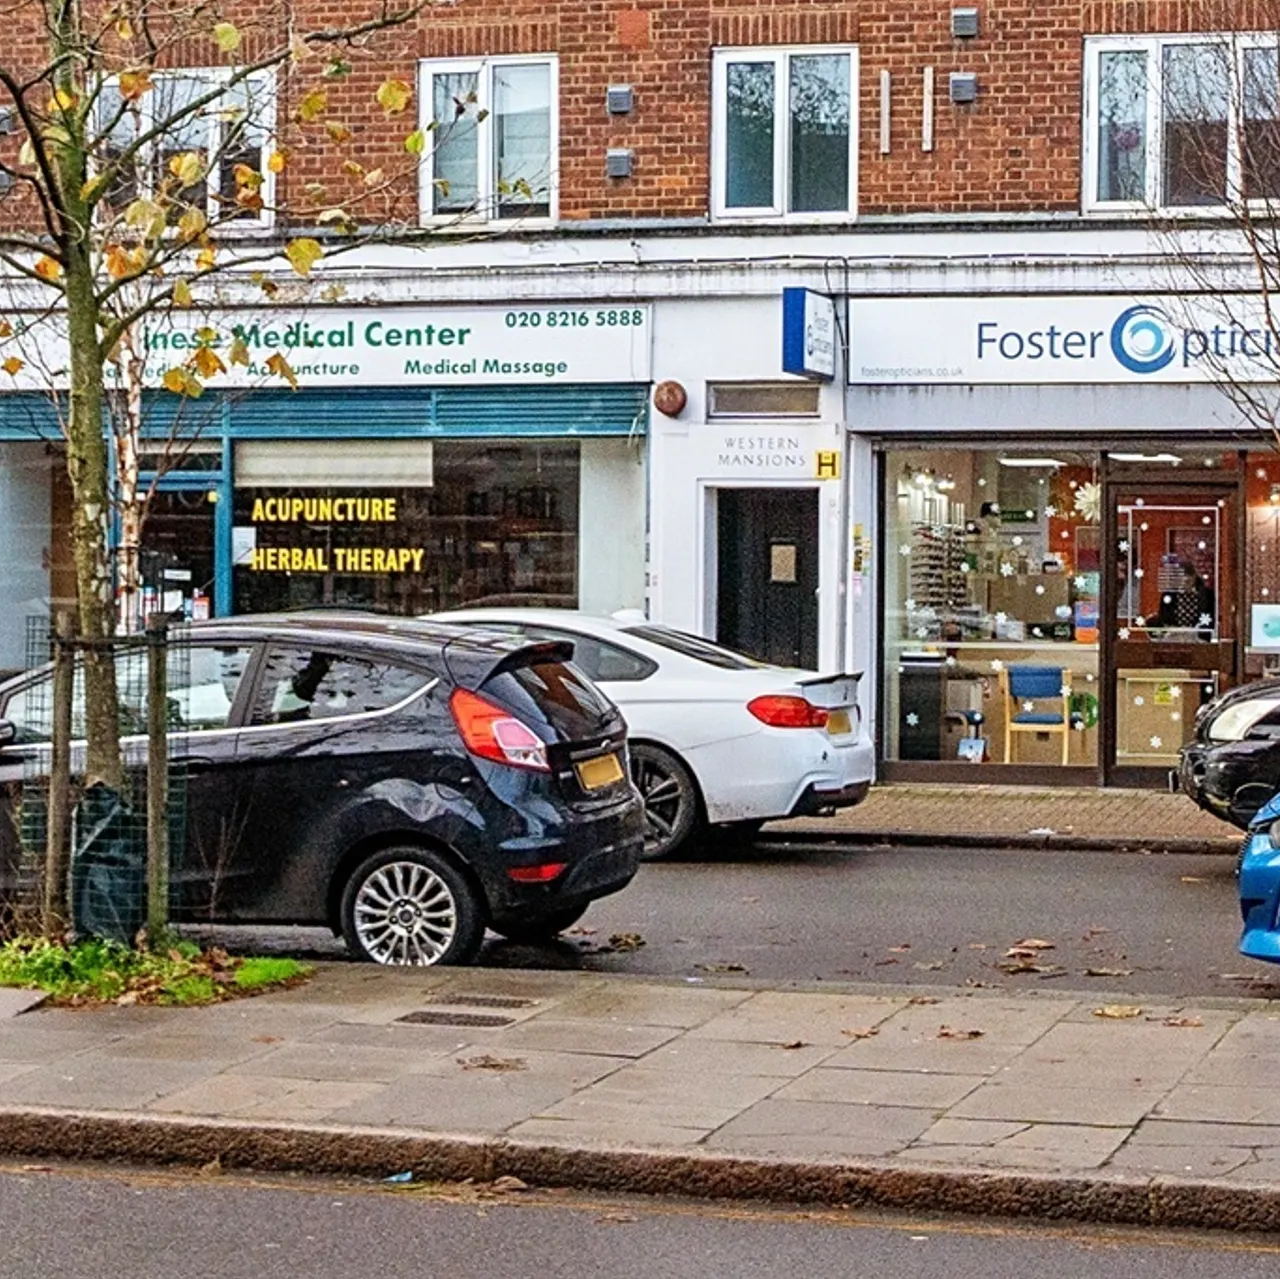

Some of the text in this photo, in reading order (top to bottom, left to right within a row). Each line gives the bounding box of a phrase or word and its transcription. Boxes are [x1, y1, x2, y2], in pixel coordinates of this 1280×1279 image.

[505, 310, 643, 328] 020 8216 5888
[234, 321, 354, 349] Medical
[364, 320, 471, 349] Center
[977, 322, 1104, 360] Foster
[404, 358, 477, 375] Medical
[483, 358, 569, 380] Massage
[860, 365, 964, 380] fosteropticians.co.uk
[724, 437, 800, 450] WESTERN
[718, 453, 806, 467] MANSIONS
[817, 452, 837, 476] H
[251, 497, 398, 522] ACUPUNCTURE
[251, 547, 425, 572] HERBAL THERAPY
